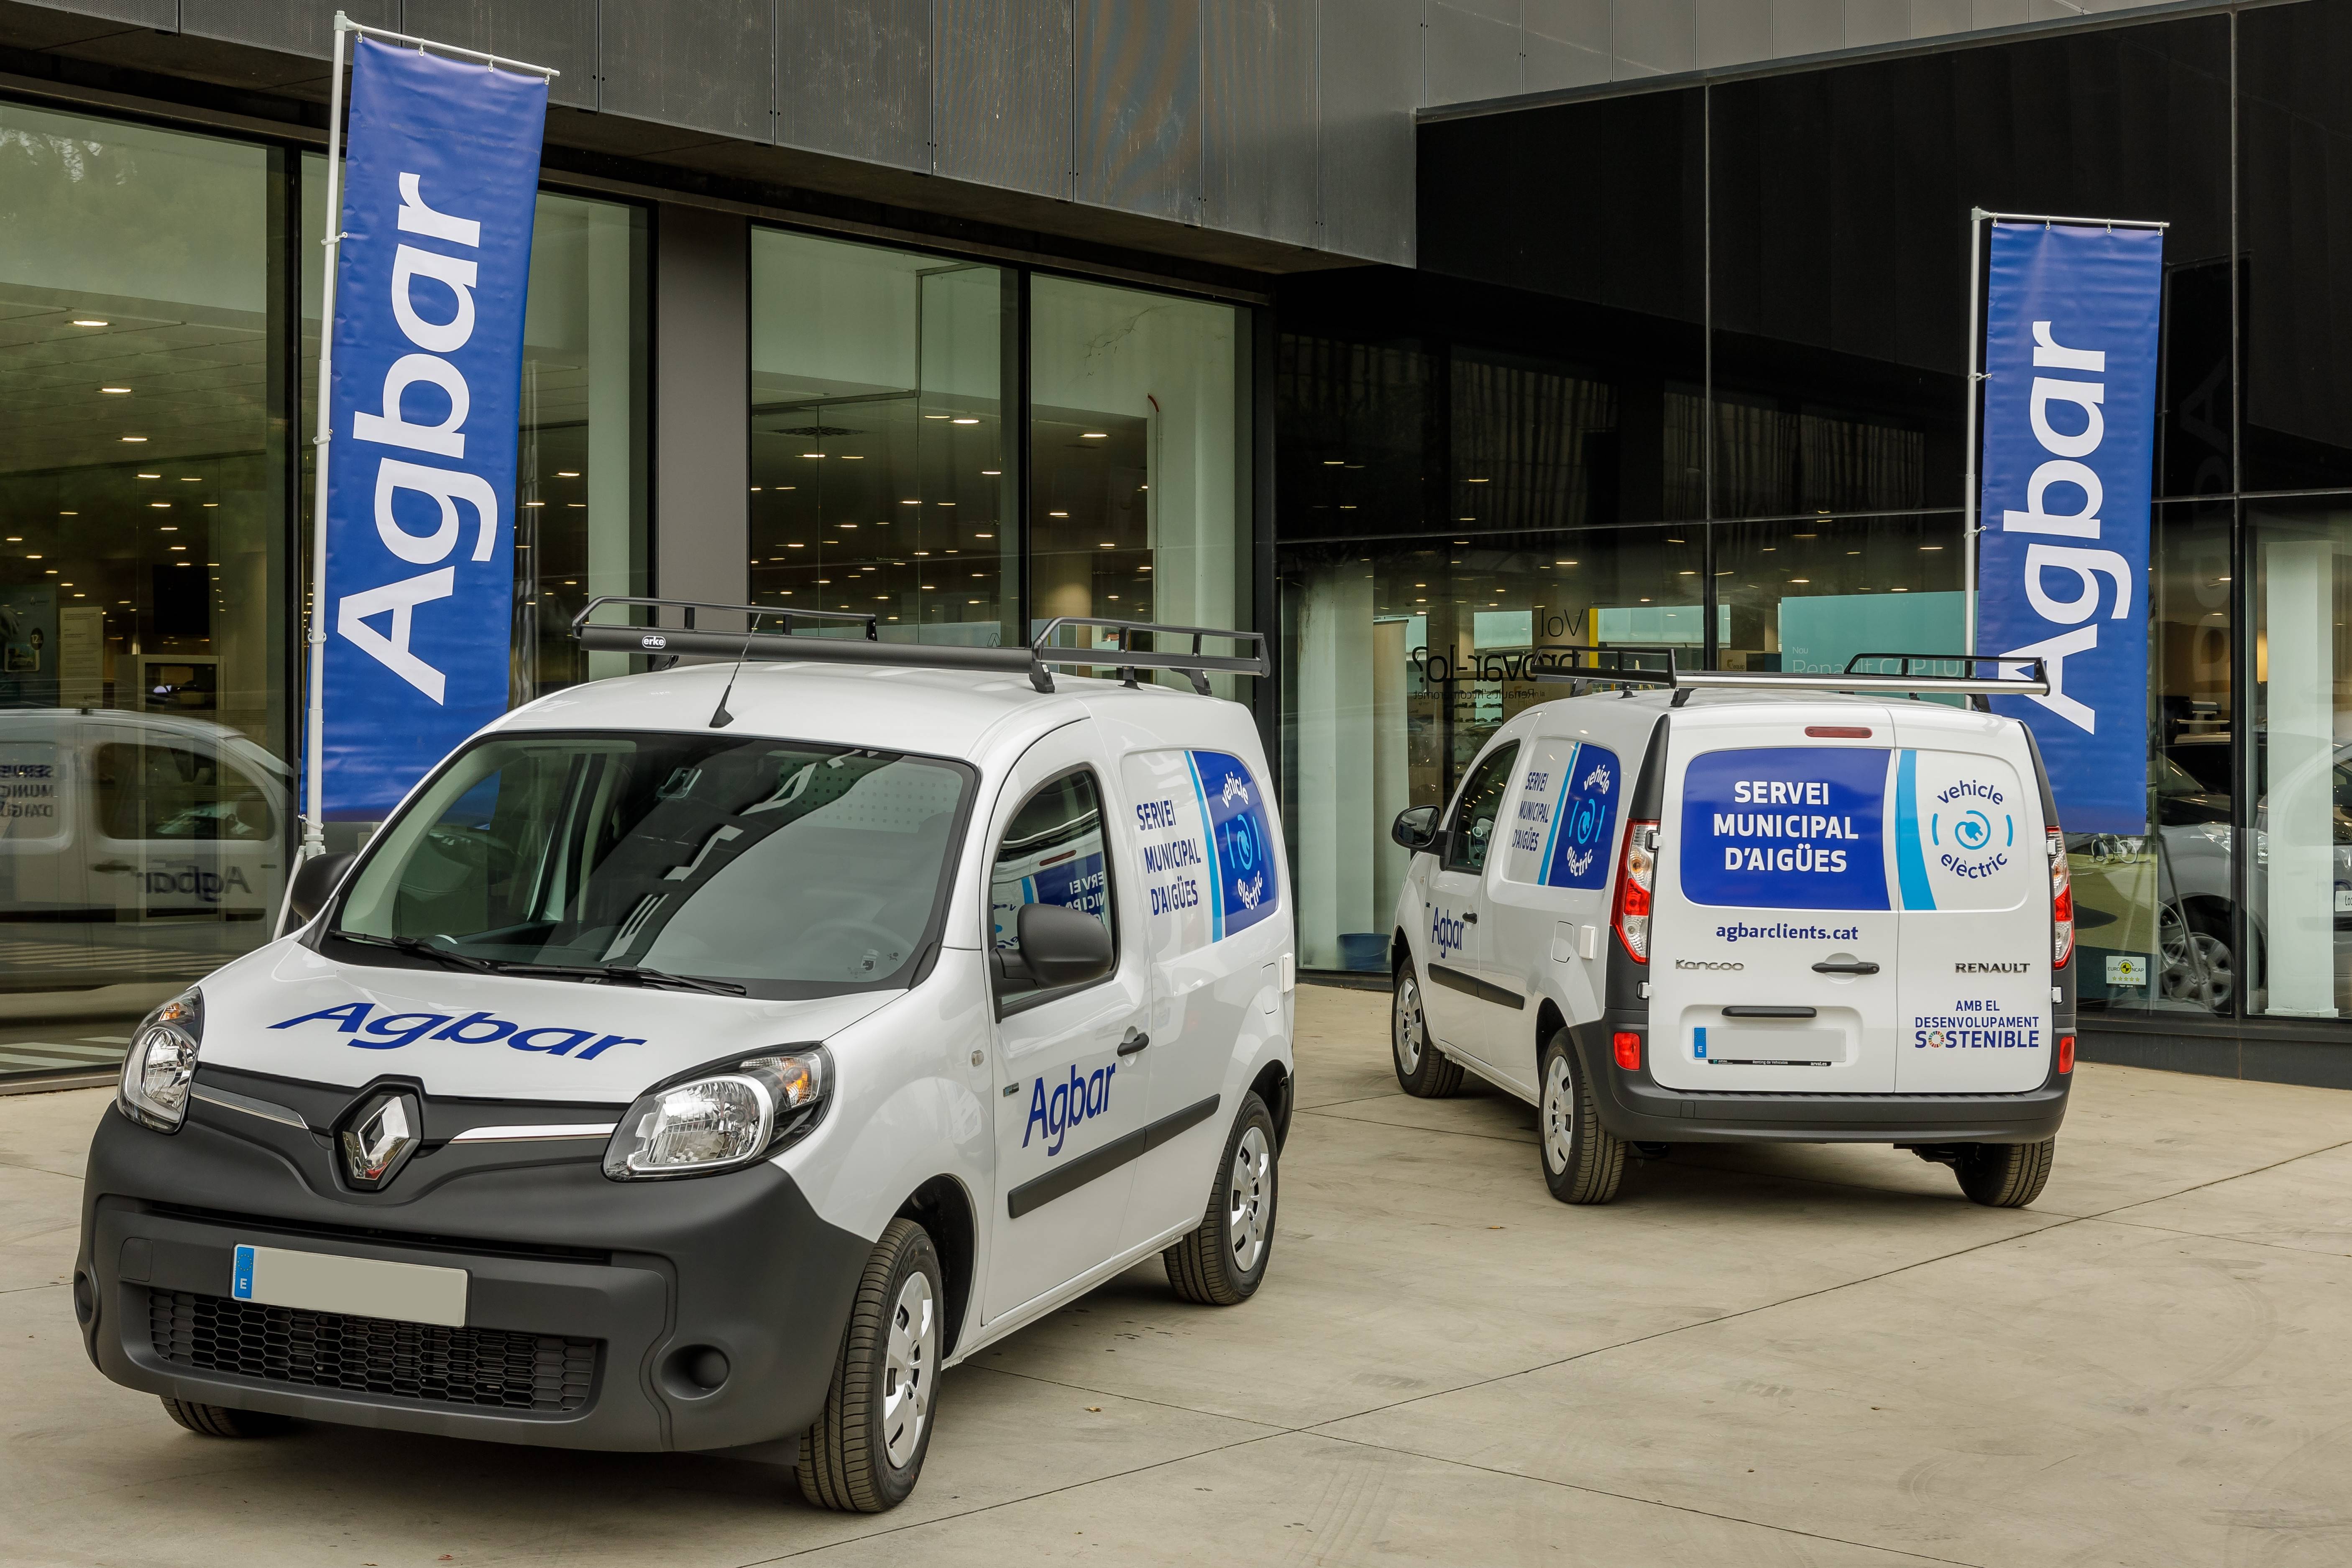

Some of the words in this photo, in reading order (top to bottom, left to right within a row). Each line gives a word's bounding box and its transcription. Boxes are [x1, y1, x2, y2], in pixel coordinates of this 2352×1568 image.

[337, 171, 498, 706] Agbar
[1998, 321, 2132, 735] Agbar
[644, 636, 664, 645] erke
[1222, 771, 1248, 808] vehicle
[1525, 772, 1549, 792] SERVEI
[1584, 764, 1611, 794] vehicle
[1734, 781, 1829, 806] SERVEI
[1937, 780, 2003, 805] vehicle
[1137, 800, 1176, 831] SERVEI
[1518, 801, 1550, 824] MUNICIPAL
[1512, 826, 1539, 852] D'AIGÜES
[1713, 813, 1858, 840] MUNICIPAL
[1144, 837, 1201, 874] MUNICIPAL
[1724, 843, 1847, 873] D'AIGÜES
[1941, 853, 2007, 879] elèctric
[1150, 879, 1199, 916] D'AIGÜES
[1432, 907, 1464, 959] Agbar
[1716, 922, 1859, 942] agbarclients.cat
[1955, 963, 2030, 973] RENAULT
[1956, 1000, 1982, 1011] AMB
[1986, 1000, 2000, 1011] EL
[268, 1002, 647, 1061] Agbar
[1915, 1017, 2039, 1028] DESENVOLUPAMENT
[1915, 1030, 2039, 1049] SOSTENIBLE
[1022, 1062, 1117, 1157] Agbar
[240, 1278, 248, 1289] E
